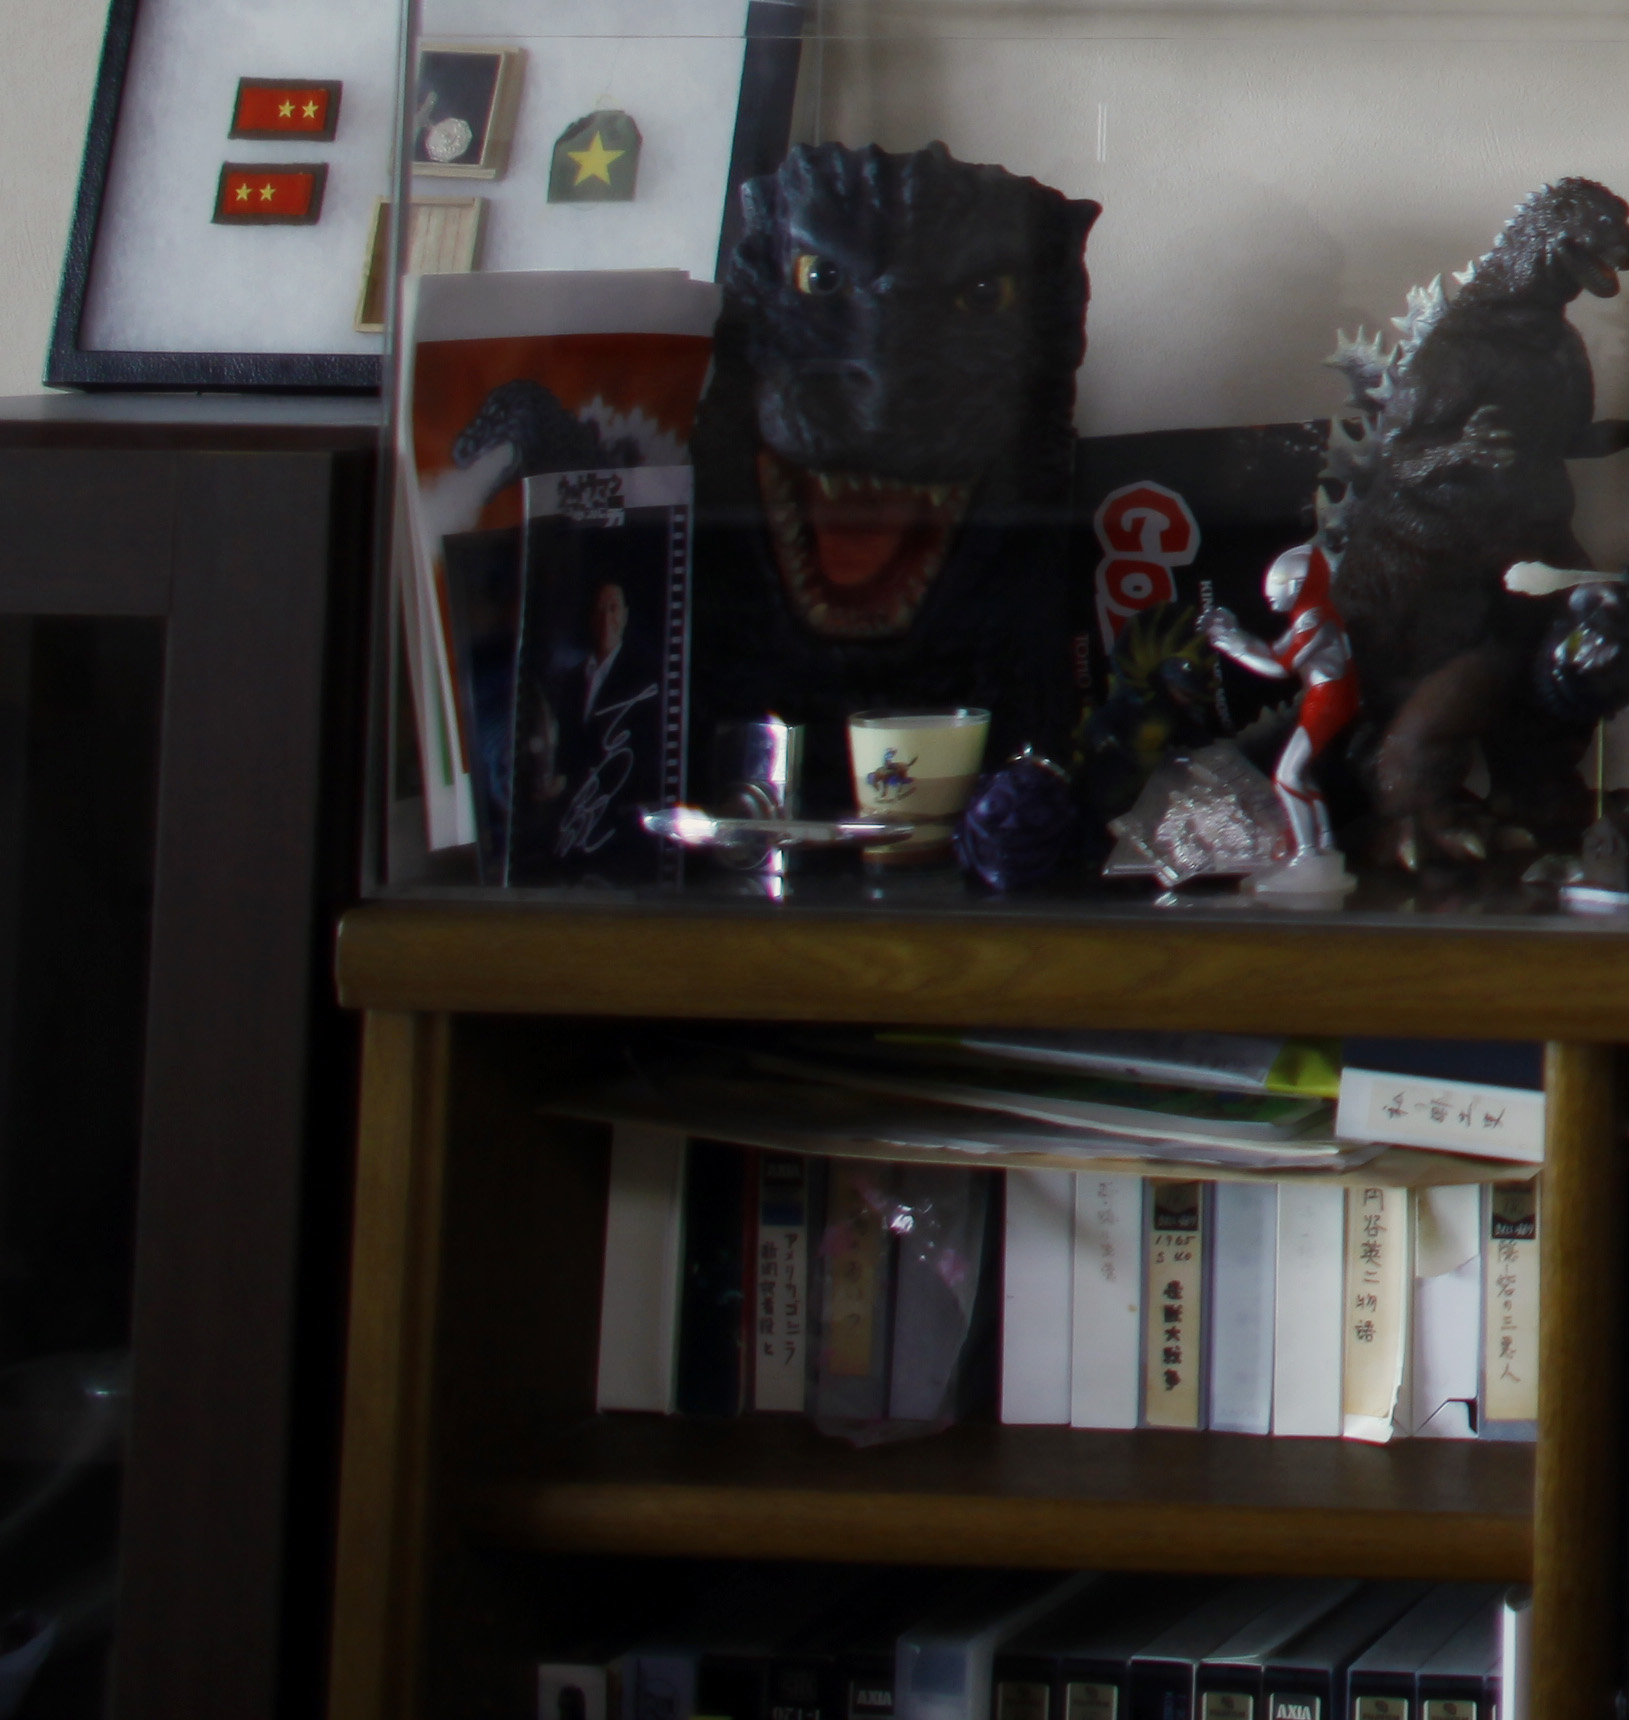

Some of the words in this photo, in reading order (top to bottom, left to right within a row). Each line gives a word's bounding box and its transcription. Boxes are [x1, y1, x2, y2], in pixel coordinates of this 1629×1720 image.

[1154, 1234, 1196, 1247] 1965
[1353, 1187, 1390, 1344] 円谷英二物語
[856, 1689, 892, 1706] AXIA
[1275, 1703, 1313, 1720] AXIA
